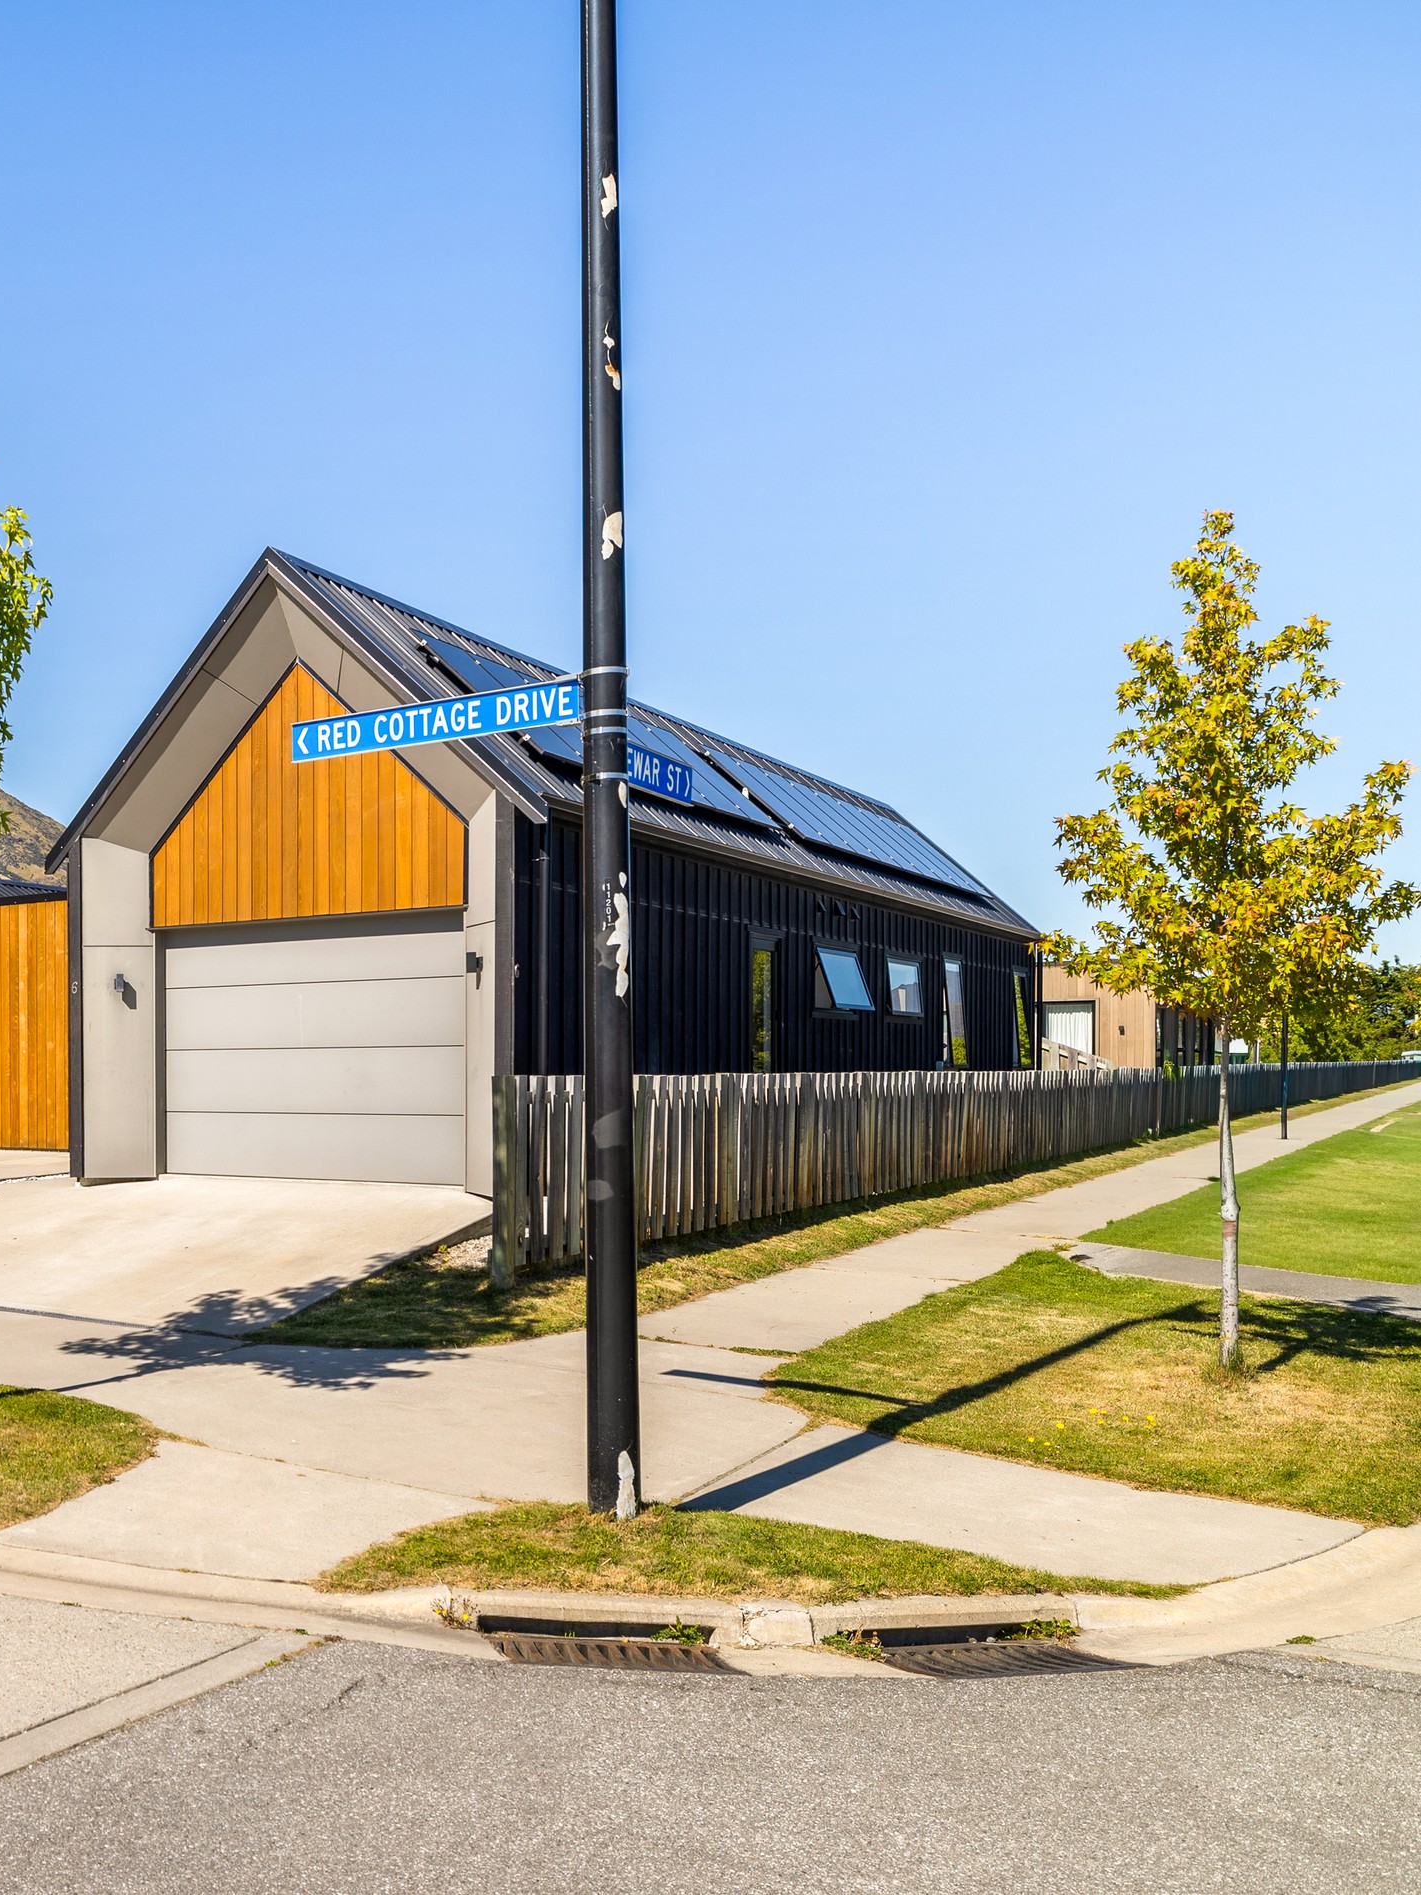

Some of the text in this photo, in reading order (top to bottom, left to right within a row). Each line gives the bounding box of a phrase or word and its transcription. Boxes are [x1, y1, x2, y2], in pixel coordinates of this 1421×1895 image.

[317, 685, 574, 753] RED COTTAGE DRIVE
[666, 763, 682, 794] ST
[71, 981, 78, 994] 6
